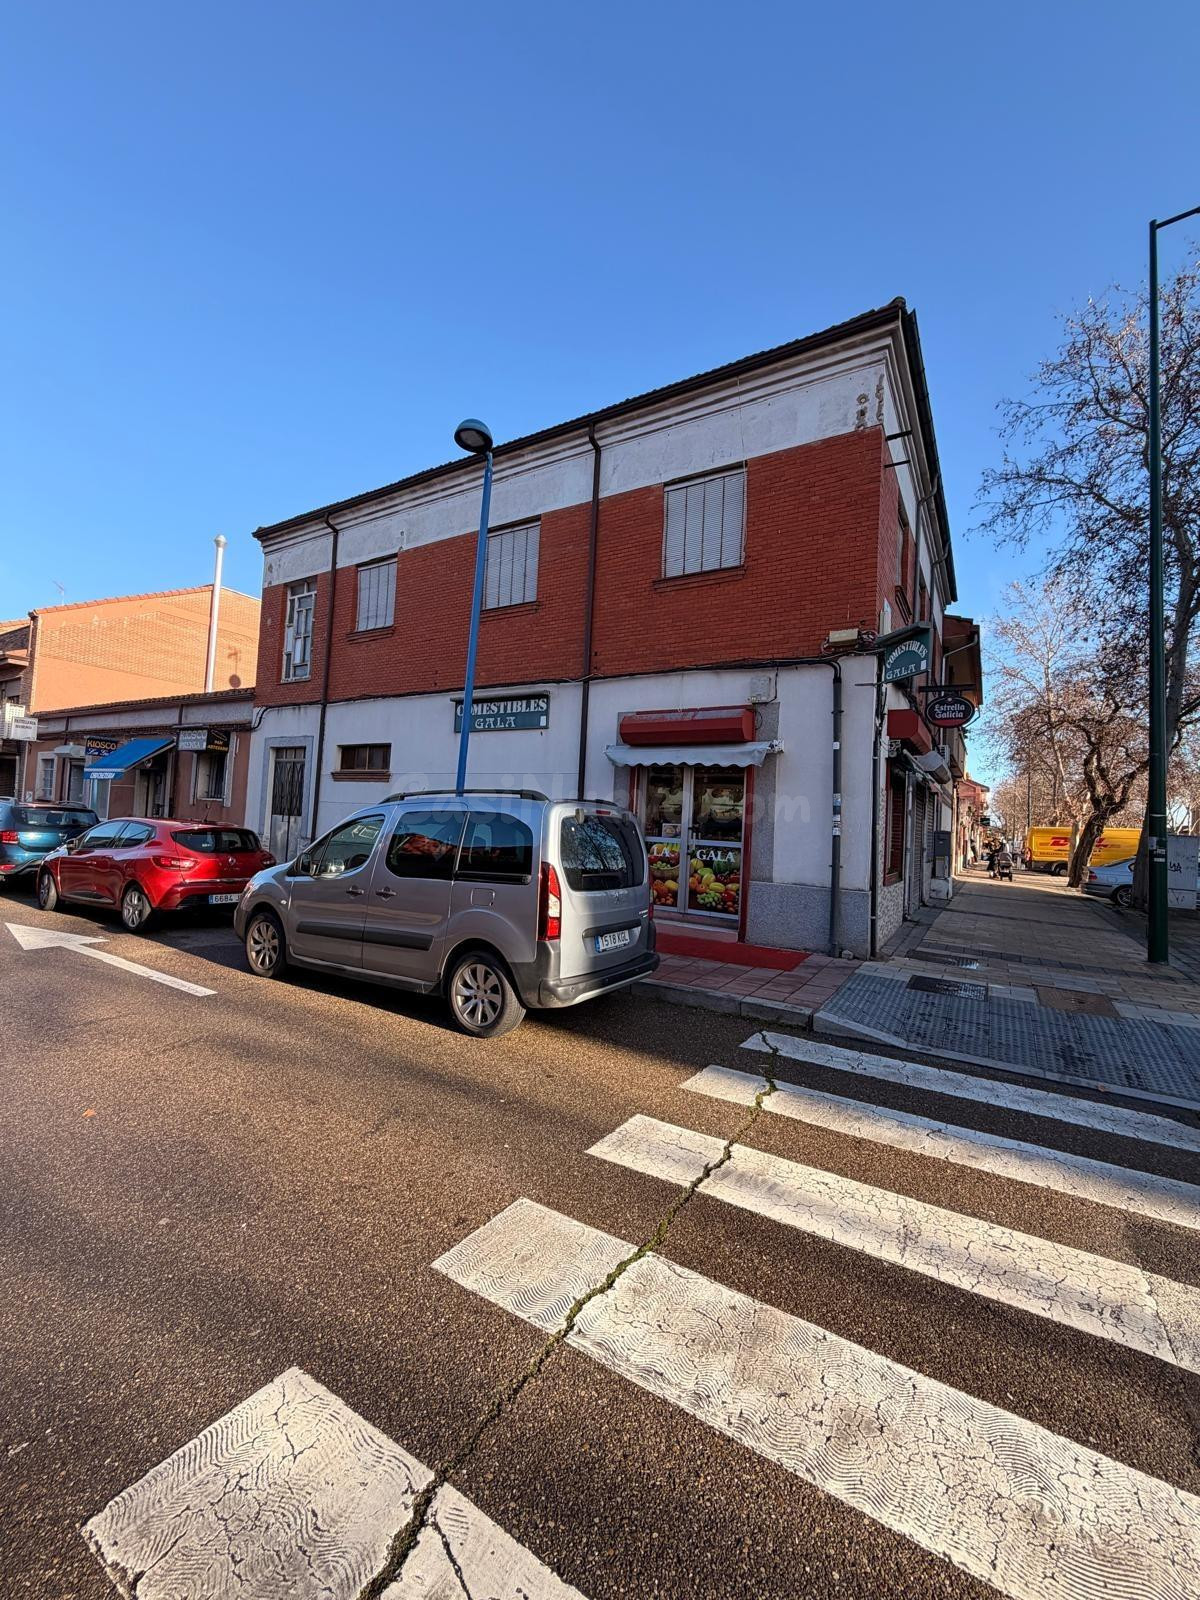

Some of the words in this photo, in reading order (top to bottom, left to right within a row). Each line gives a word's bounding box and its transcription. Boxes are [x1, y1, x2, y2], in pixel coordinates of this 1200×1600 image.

[886, 640, 928, 668] COMESTIBLES
[886, 664, 916, 680] GALA
[456, 698, 548, 717] CMESTIBLES
[934, 703, 966, 712] Estrella
[935, 710, 964, 719] Galicia
[474, 716, 516, 729] GALA
[87, 739, 117, 751] KIOSCO
[652, 846, 670, 858] LA
[696, 848, 736, 863] GALA
[214, 894, 234, 903] 6684
[600, 932, 617, 949] 1518
